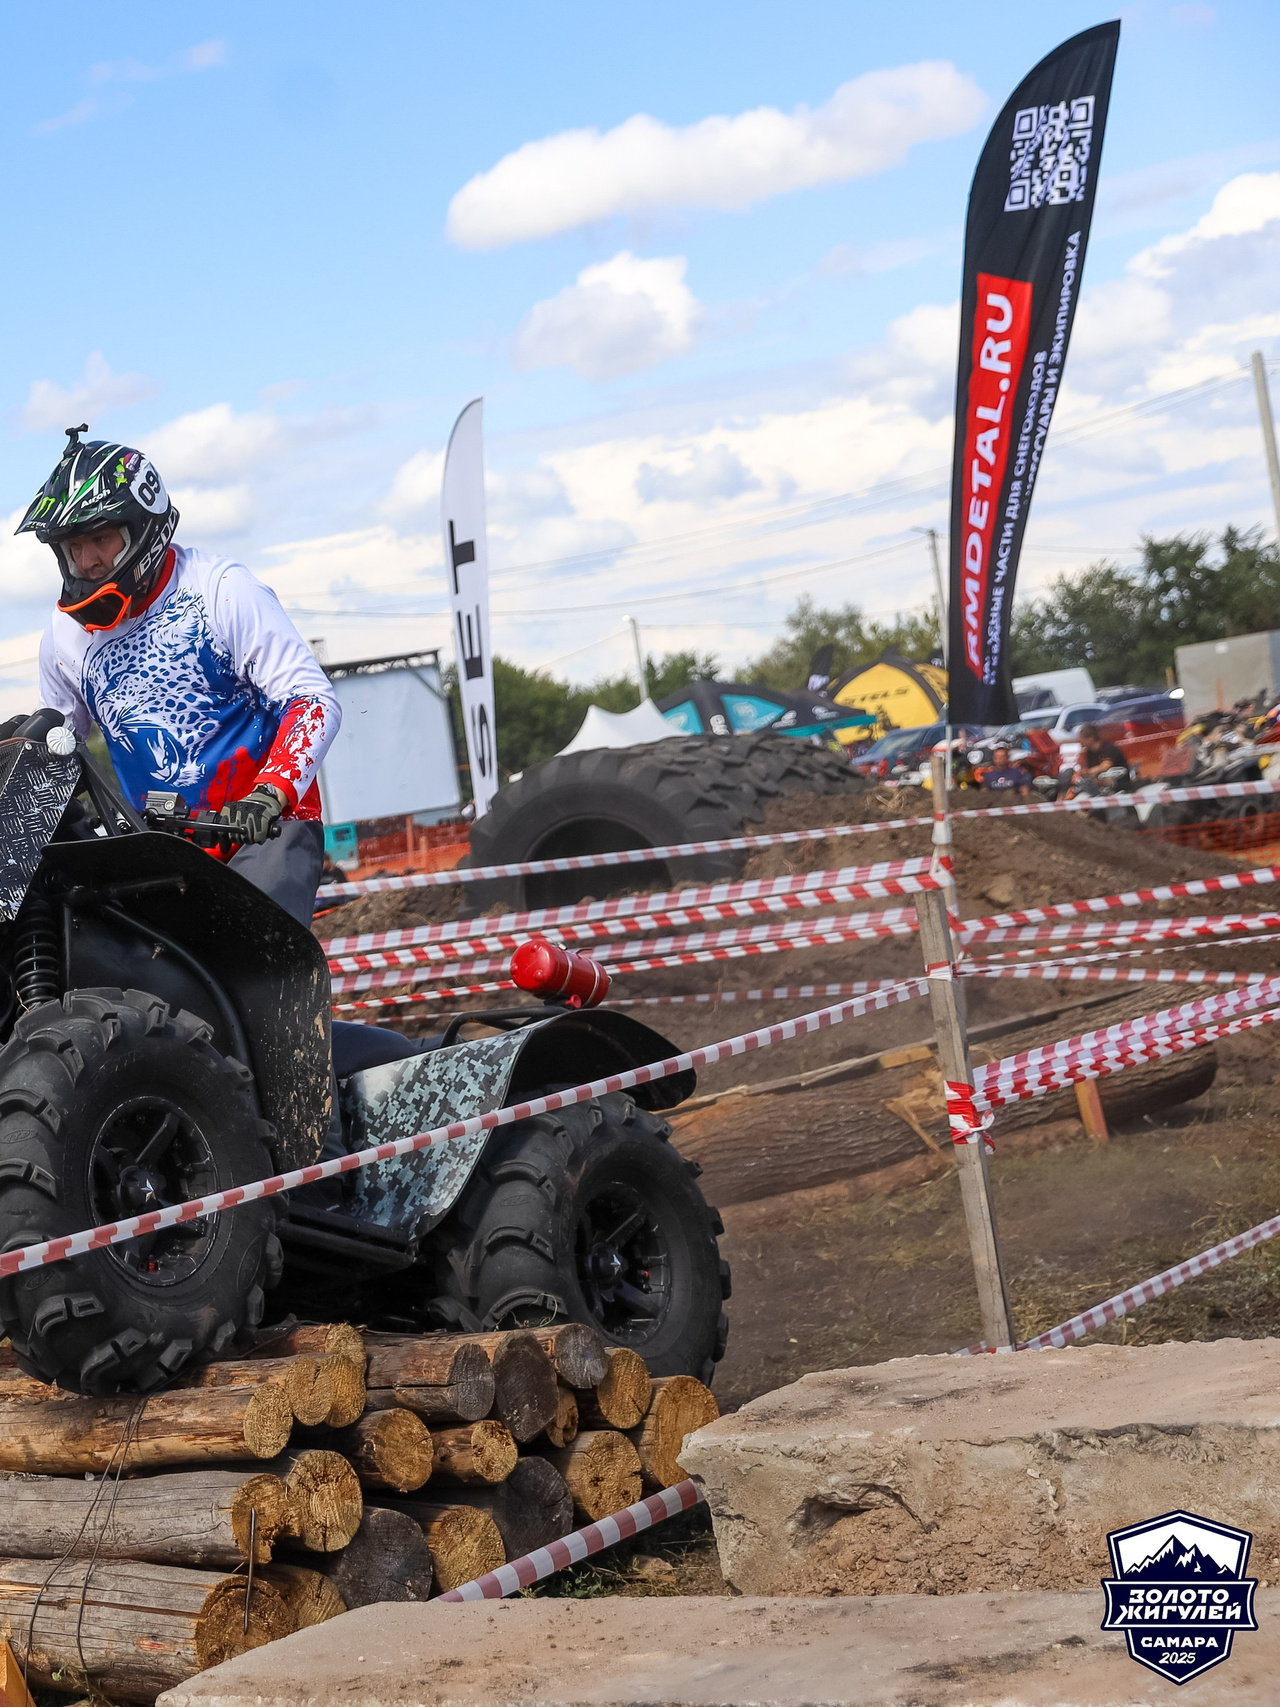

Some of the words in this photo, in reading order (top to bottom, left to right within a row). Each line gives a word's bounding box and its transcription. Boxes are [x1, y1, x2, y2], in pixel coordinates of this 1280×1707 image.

[1048, 230, 1081, 365] ЭКИПИРОВКА
[1045, 368, 1059, 384] И
[994, 522, 1015, 583] ЧАСТИ
[1005, 480, 1023, 520] ДЛЯ
[1014, 350, 1048, 477] СНЕГОХОДОВ
[81, 489, 111, 508] Airoh
[138, 470, 161, 507] 09
